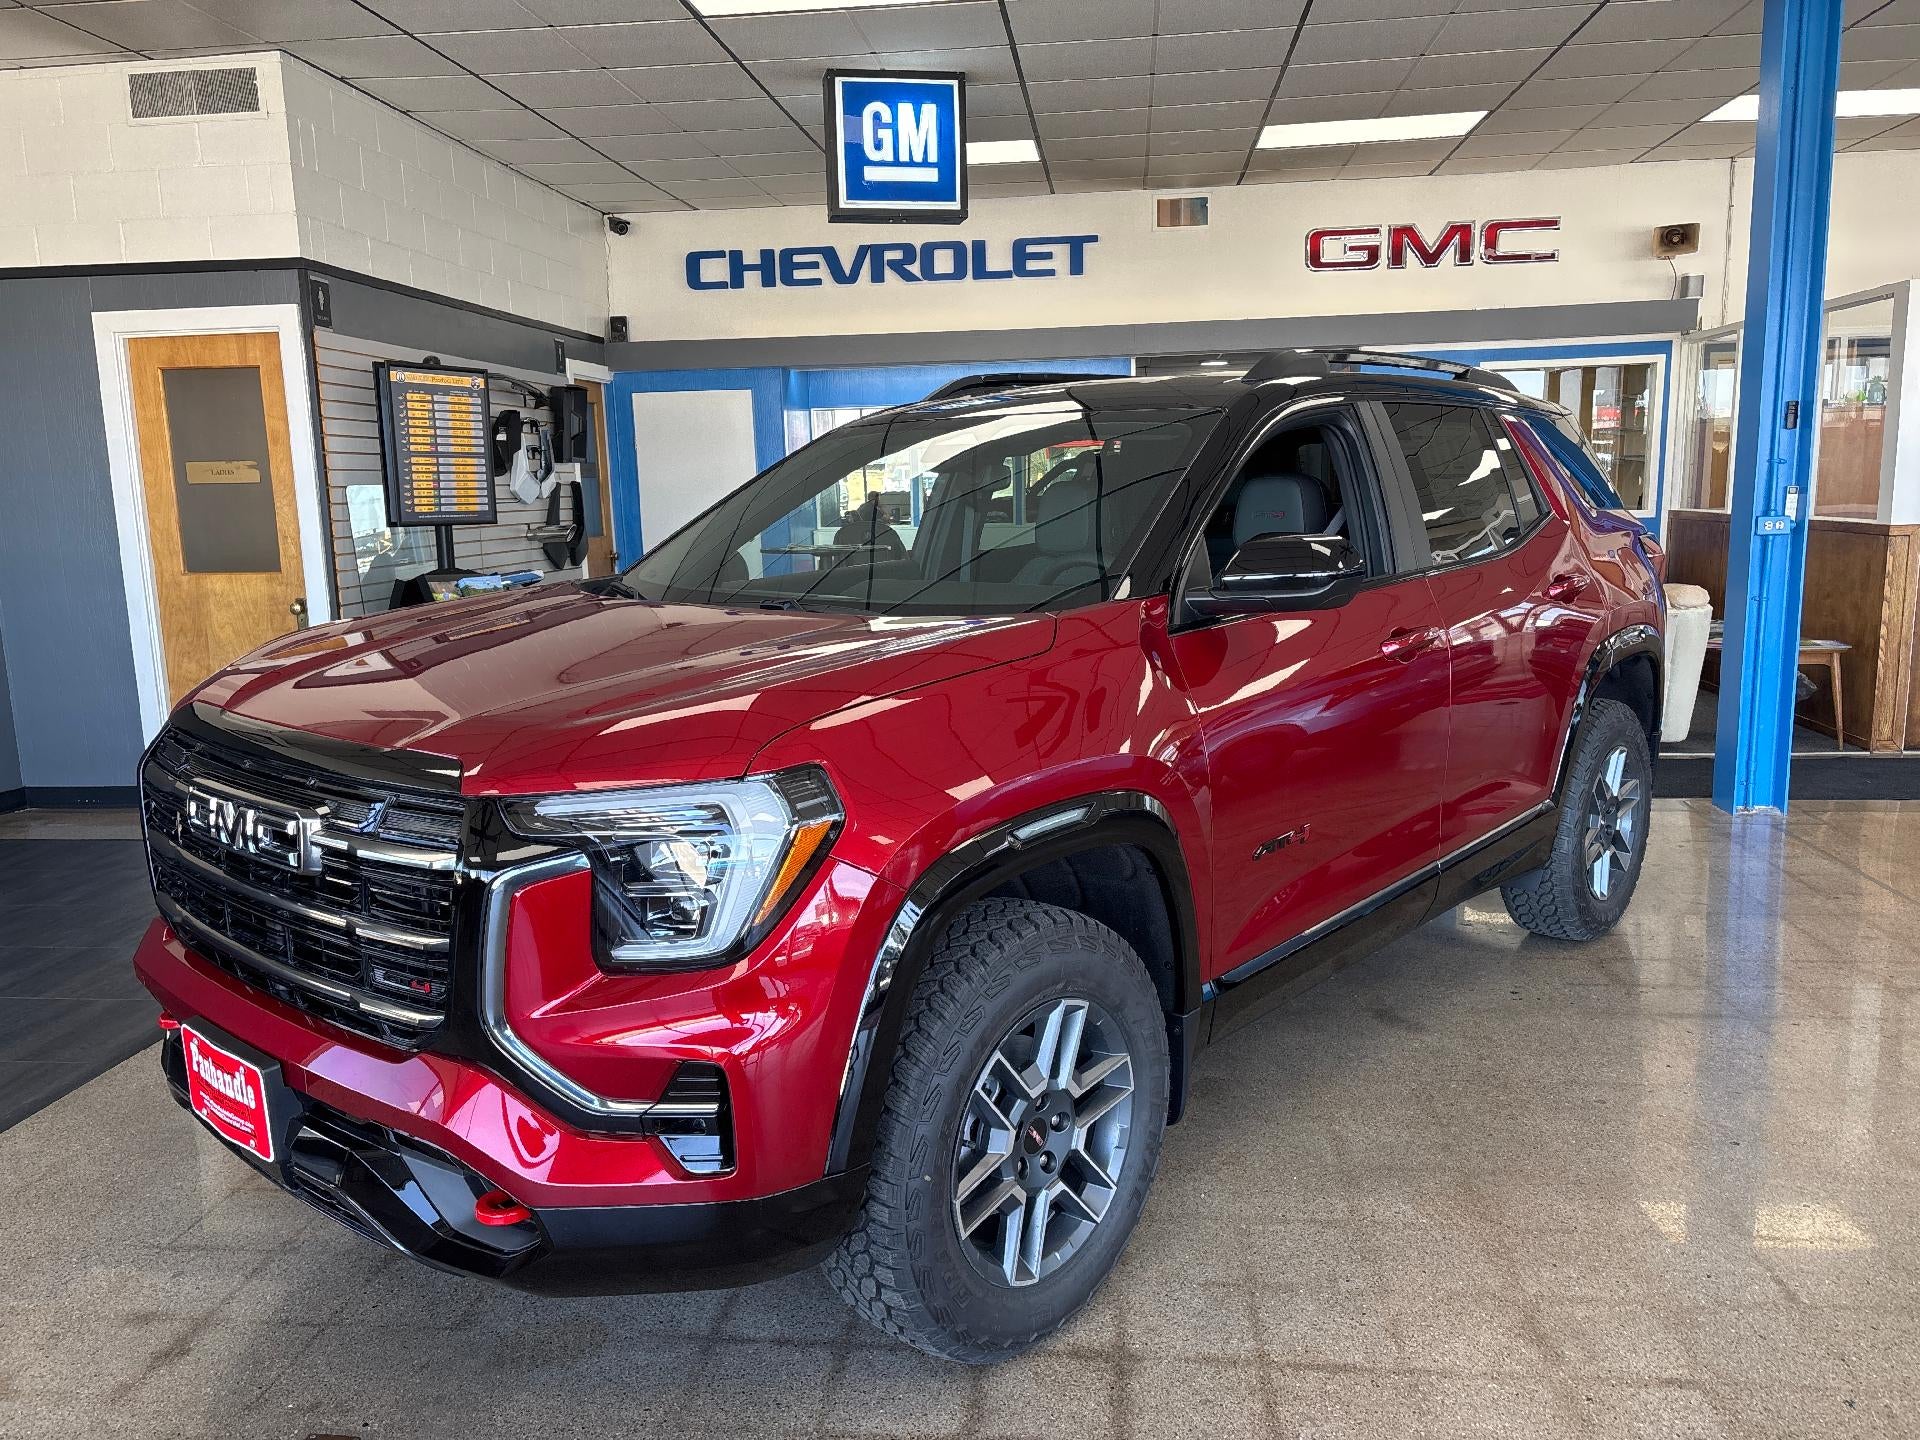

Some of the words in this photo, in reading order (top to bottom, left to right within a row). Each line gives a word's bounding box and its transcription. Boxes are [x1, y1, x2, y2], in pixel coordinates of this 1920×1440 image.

[862, 101, 938, 163] GM
[685, 234, 1099, 291] CHEVROLET
[1305, 216, 1561, 272] GMC
[187, 786, 324, 876] GMC
[190, 1041, 256, 1109] Panhandle
